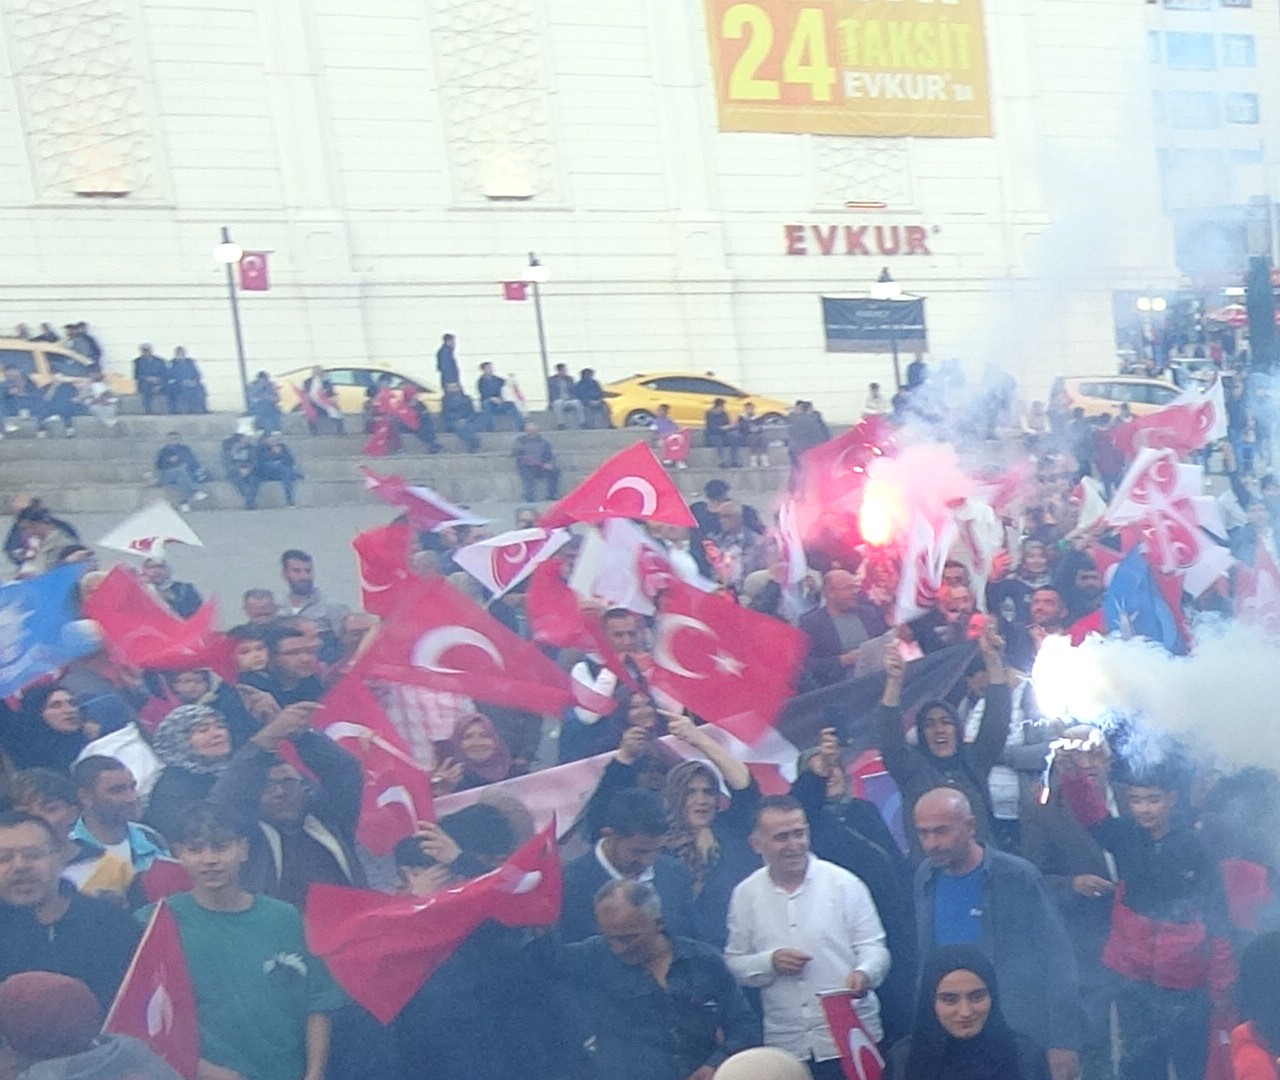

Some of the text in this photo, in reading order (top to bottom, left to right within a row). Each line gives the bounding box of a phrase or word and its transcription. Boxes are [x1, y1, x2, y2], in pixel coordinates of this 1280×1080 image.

[721, 4, 973, 101] 24 TAKSİT
[784, 224, 932, 256] EVKUR
